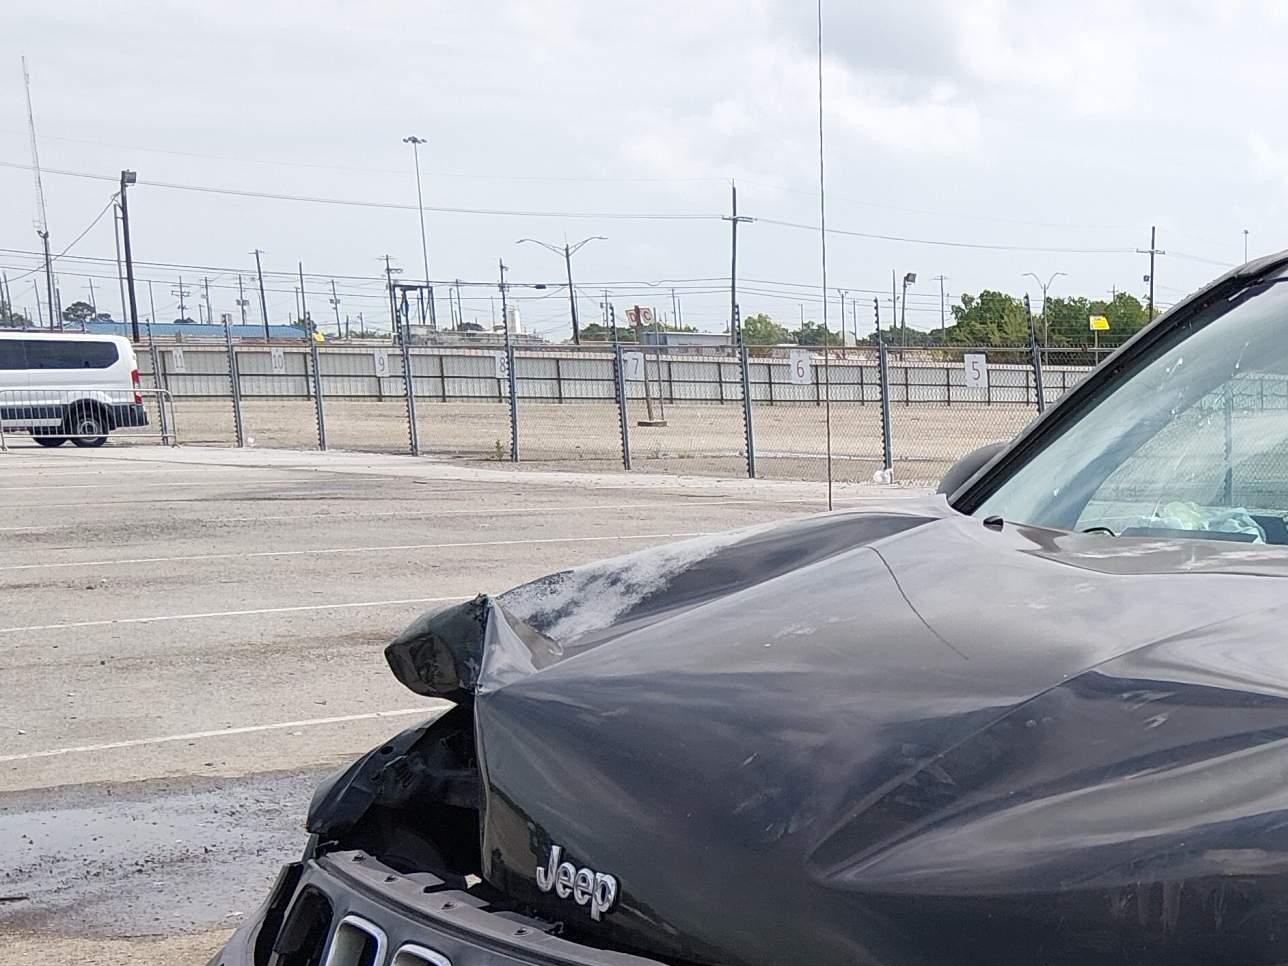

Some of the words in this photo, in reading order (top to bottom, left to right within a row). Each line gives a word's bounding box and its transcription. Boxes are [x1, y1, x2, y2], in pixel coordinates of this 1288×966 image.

[272, 353, 284, 370] 10
[378, 356, 385, 372] 9
[499, 357, 506, 373] 8
[631, 357, 639, 375] 7
[796, 359, 805, 378] 6
[971, 360, 981, 381] 5
[536, 845, 618, 922] Jeep
